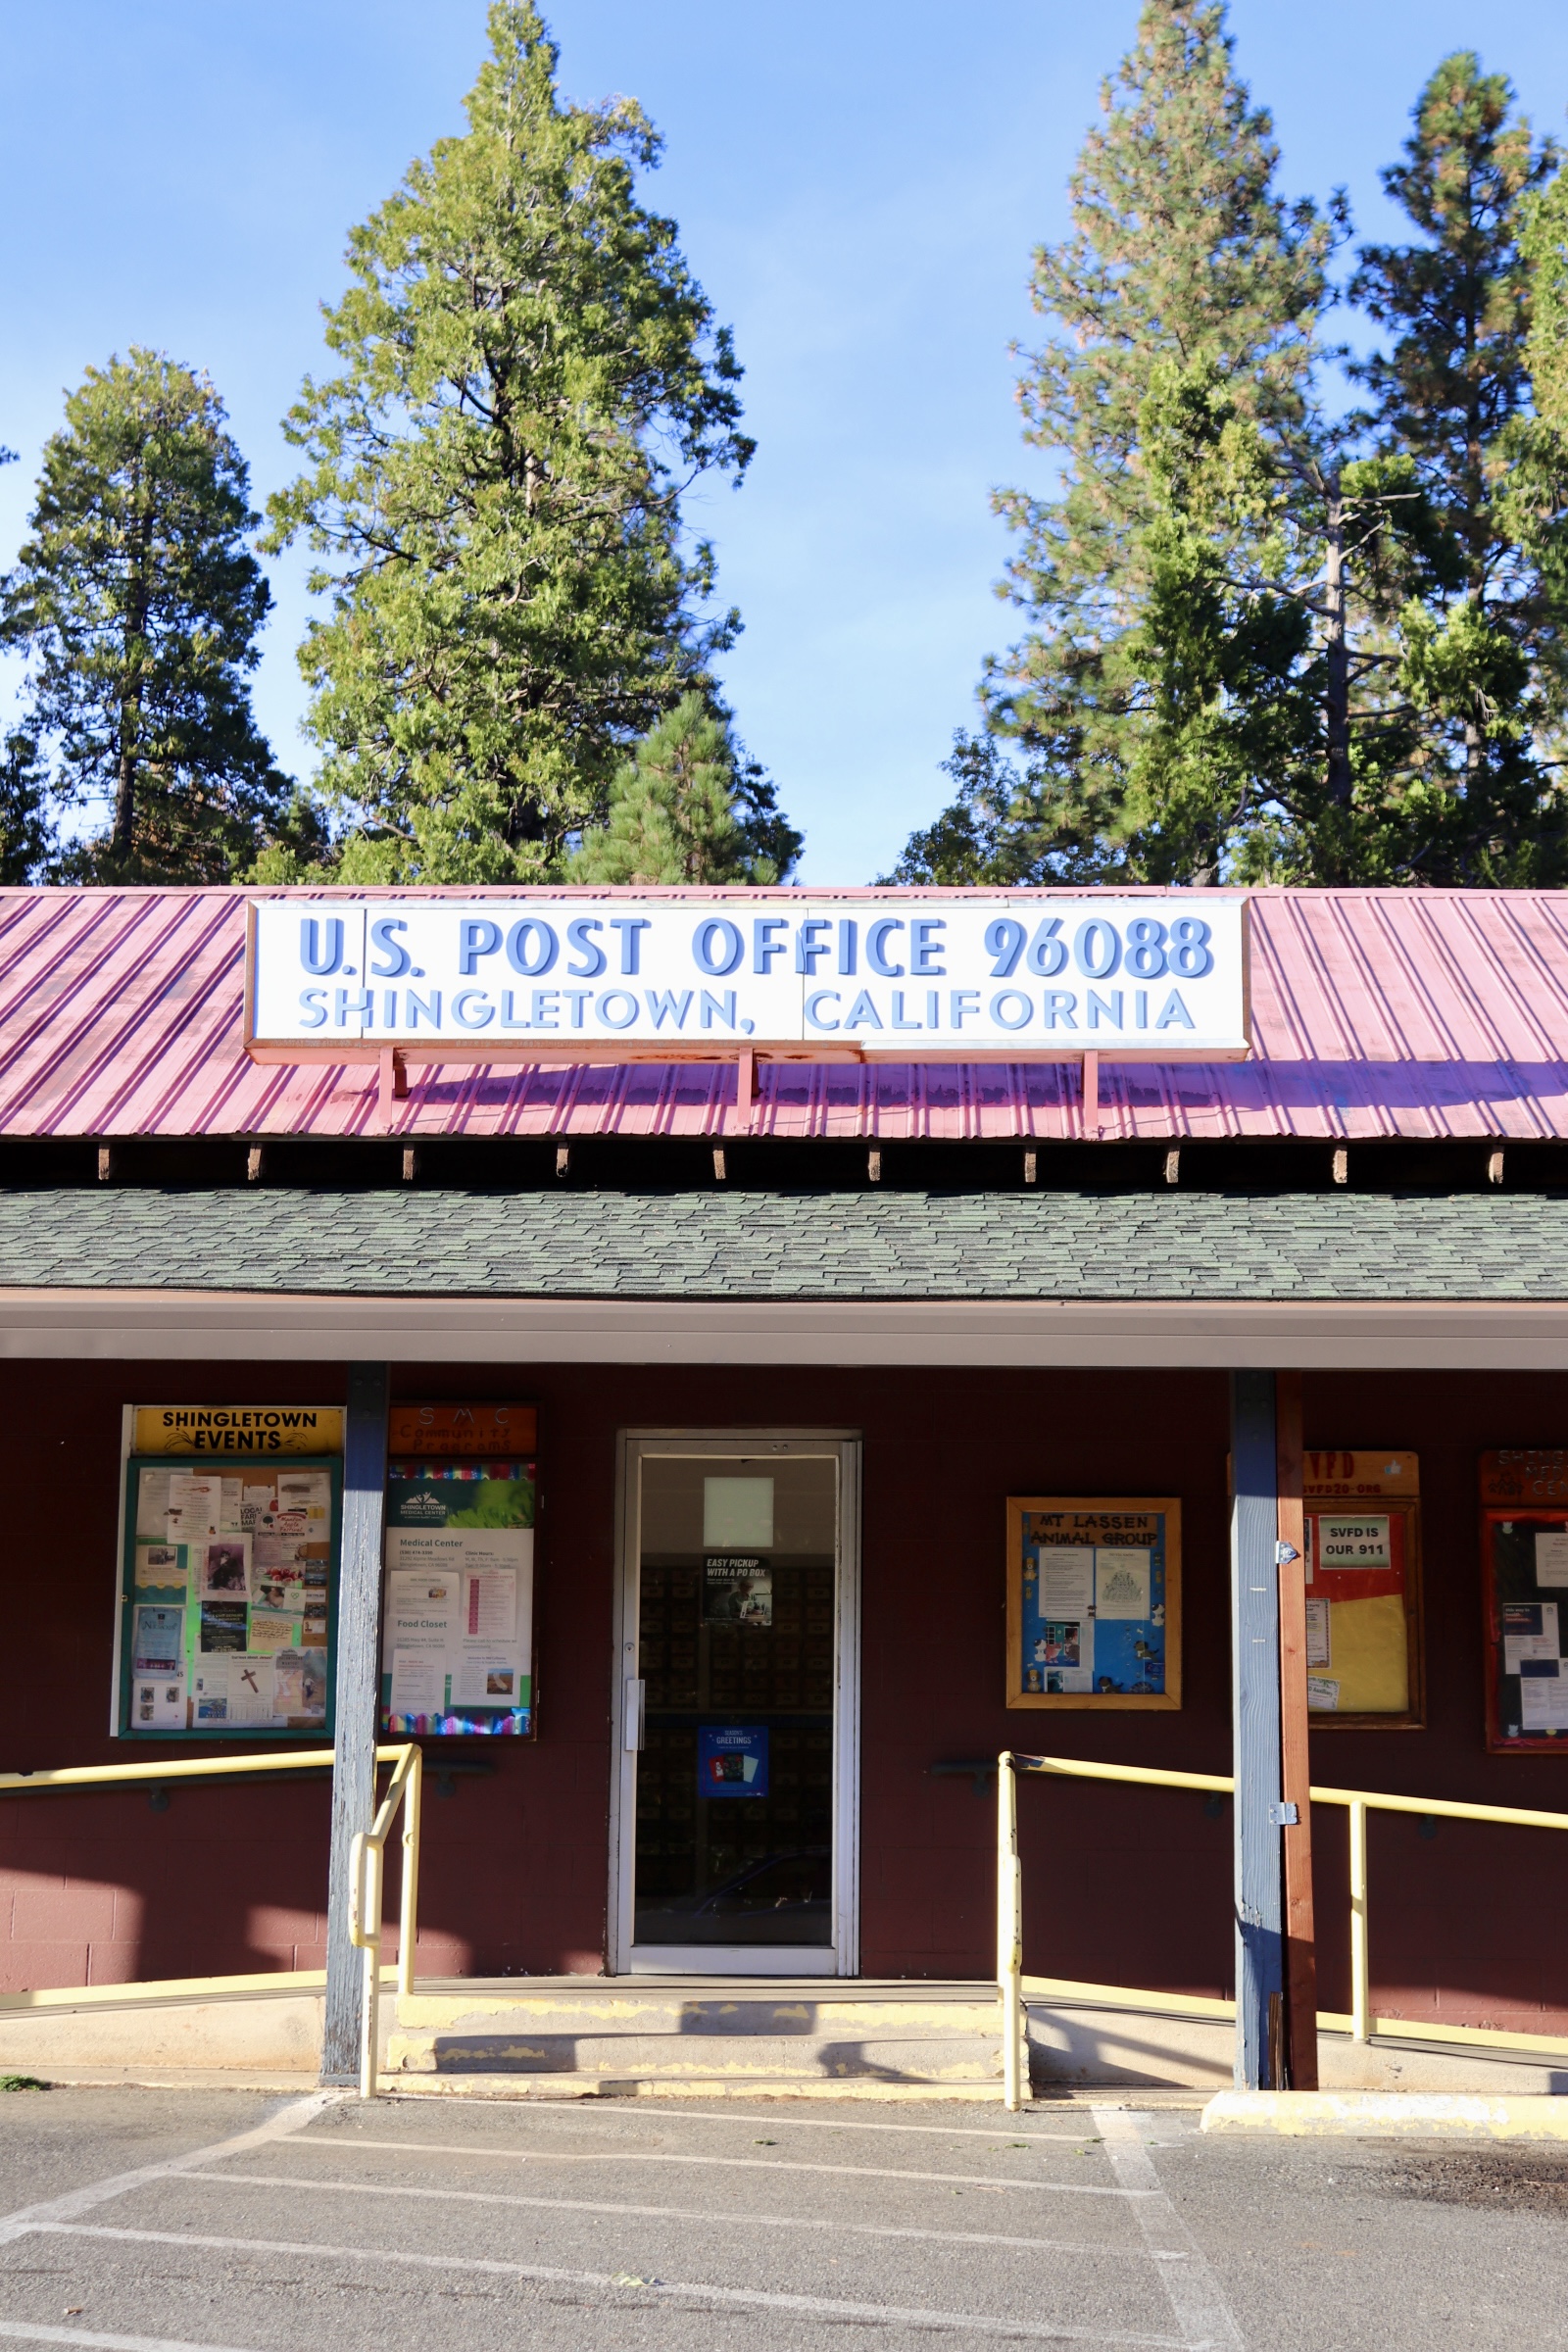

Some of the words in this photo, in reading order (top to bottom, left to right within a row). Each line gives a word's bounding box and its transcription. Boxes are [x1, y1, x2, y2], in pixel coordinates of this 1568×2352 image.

[299, 917, 425, 977] U.S.
[459, 917, 651, 977] POST
[691, 917, 947, 976] OFFICE
[984, 916, 1214, 978] 96088
[298, 987, 755, 1034] SHINGLETOWN,
[804, 988, 1196, 1031] CALIFORNIA
[163, 1411, 318, 1428] SHINGLETOWN
[400, 1424, 511, 1440] Community
[194, 1430, 281, 1450] EVENTS
[1498, 1449, 1565, 1465] SHING
[1302, 1452, 1354, 1480] VFD
[1525, 1465, 1568, 1481] MED
[1533, 1480, 1568, 1495] CEN
[1040, 1515, 1064, 1527] MT
[1073, 1516, 1148, 1529] LASSEN
[1030, 1531, 1096, 1544] ANIMAL
[1102, 1532, 1158, 1545] GROUP
[1330, 1528, 1363, 1538] SVFD
[1366, 1528, 1379, 1538] IS
[400, 1539, 433, 1547] Medical
[435, 1539, 463, 1547] Center
[1326, 1544, 1353, 1555] OUR
[1359, 1544, 1383, 1555] 911
[707, 1559, 729, 1568] EASY
[729, 1559, 760, 1568] PICKUP
[707, 1568, 728, 1576] WITH
[729, 1568, 735, 1576] A
[397, 1619, 419, 1628] Food
[420, 1619, 447, 1628] Closet
[716, 1736, 752, 1744] GREETINGS
